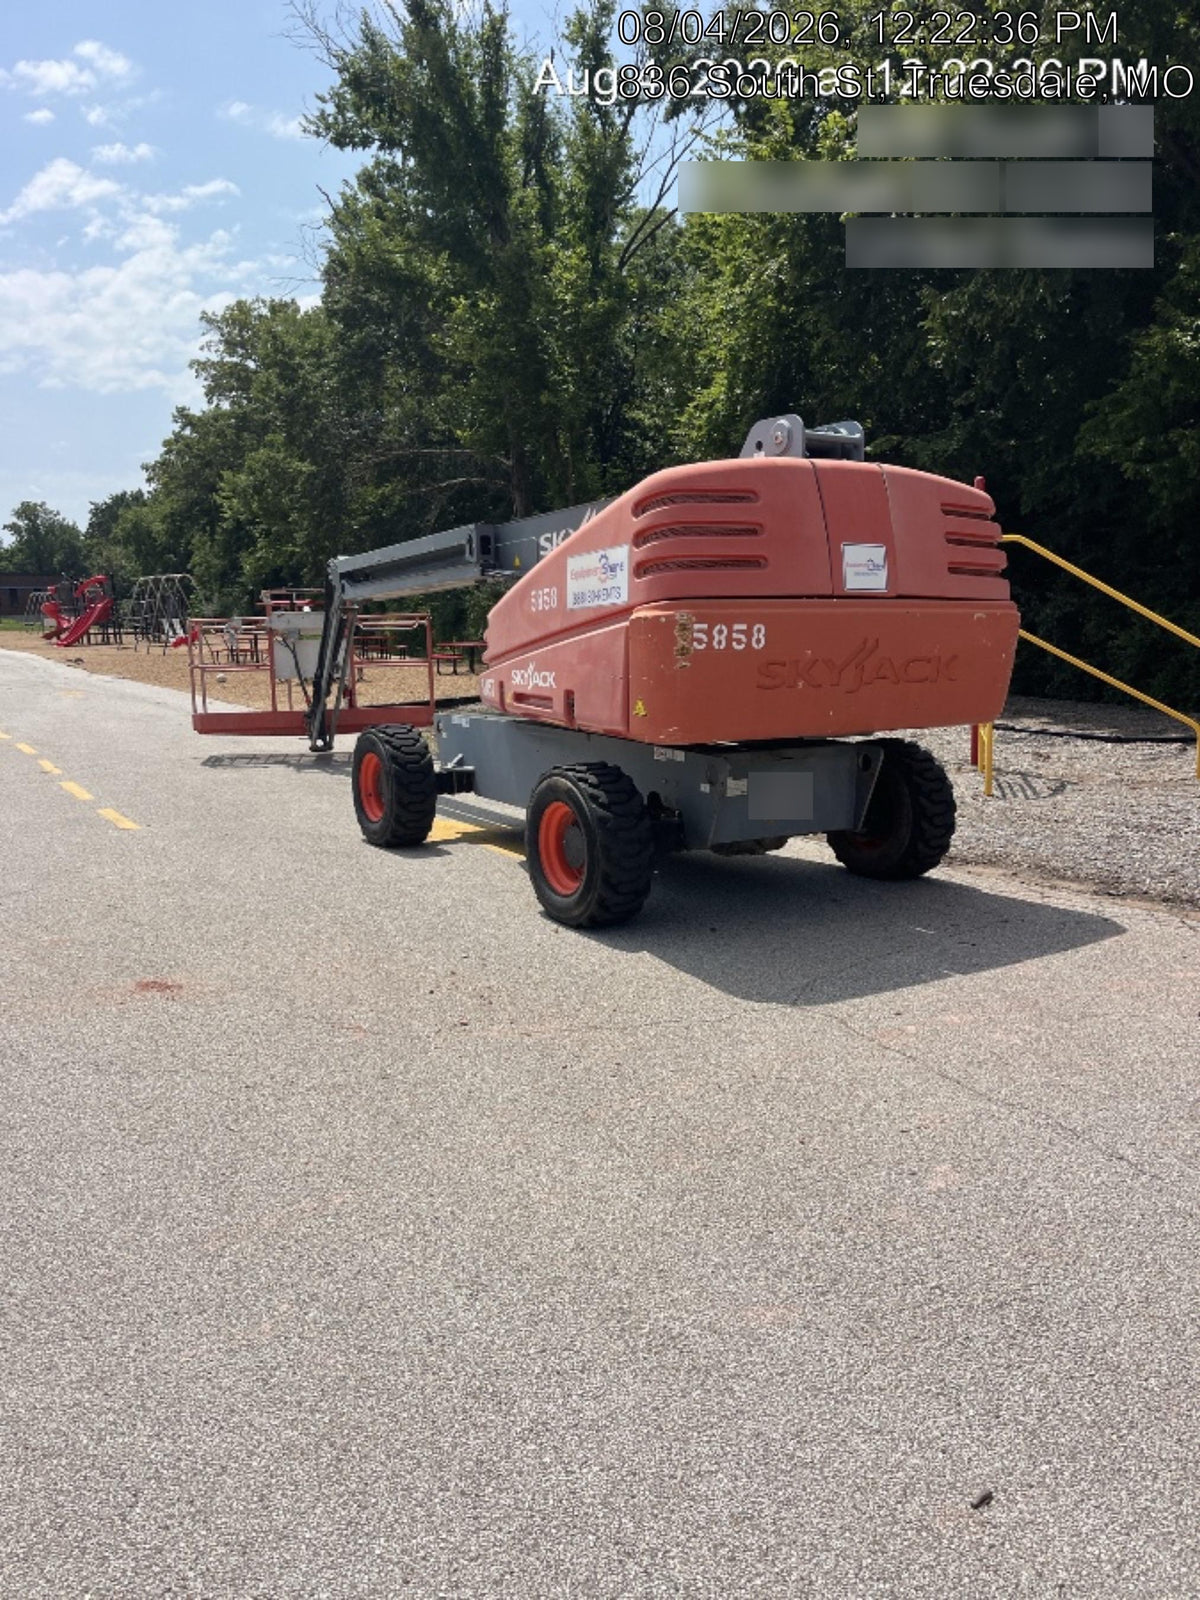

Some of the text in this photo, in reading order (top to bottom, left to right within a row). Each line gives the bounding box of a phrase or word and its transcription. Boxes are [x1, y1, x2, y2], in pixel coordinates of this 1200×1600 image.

[692, 624, 766, 650] 5858
[511, 661, 557, 690] SKYJACK
[756, 637, 959, 694] SKYJACK
